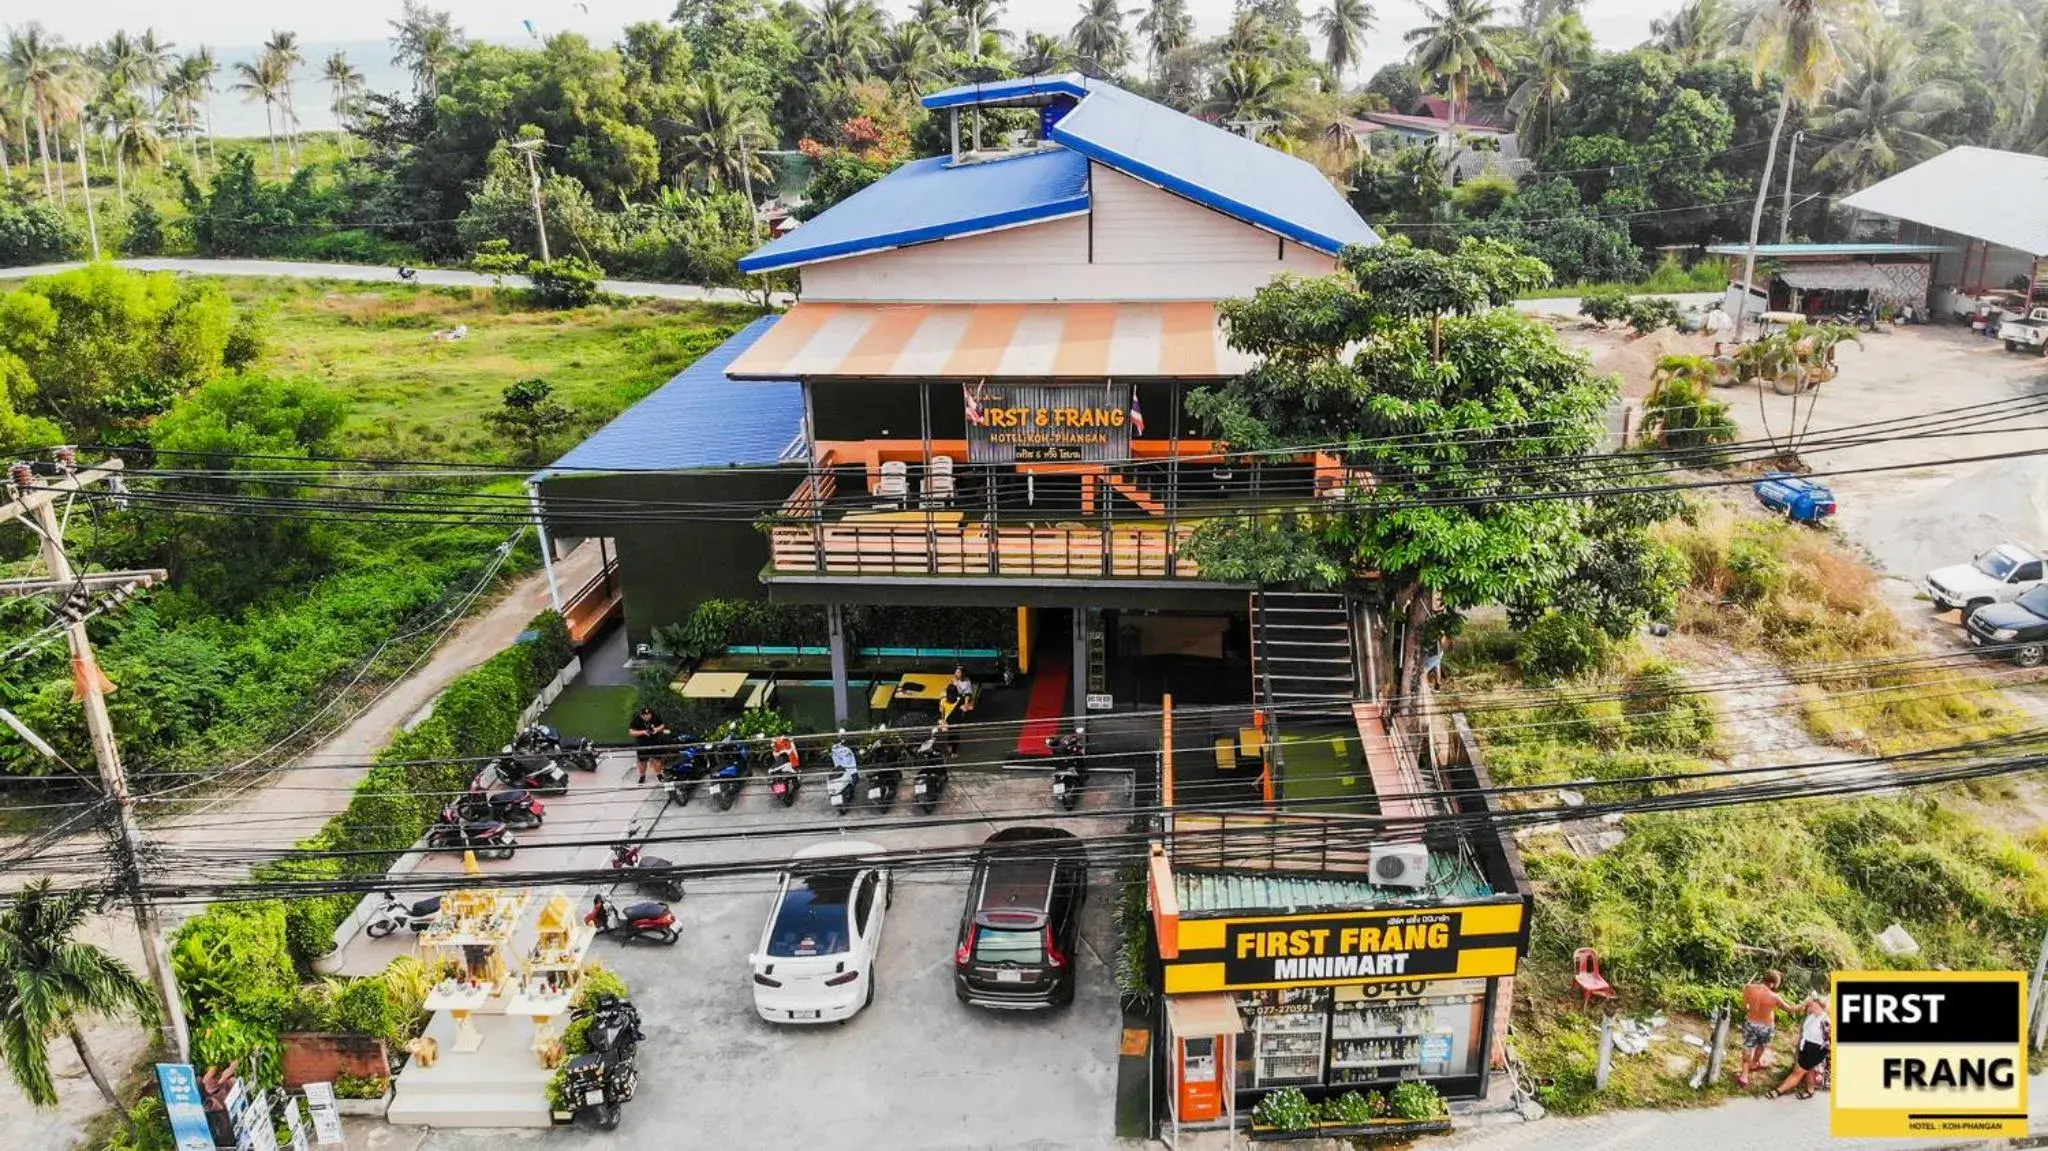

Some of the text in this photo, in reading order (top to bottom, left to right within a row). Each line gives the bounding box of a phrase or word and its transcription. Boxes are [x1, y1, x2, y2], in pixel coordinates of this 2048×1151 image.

[981, 407, 1125, 427] IRST & FRANG
[1237, 923, 1450, 959] FIRST FRANG
[1274, 953, 1410, 980] MINIMART
[1257, 1004, 1314, 1015] 077-270591
